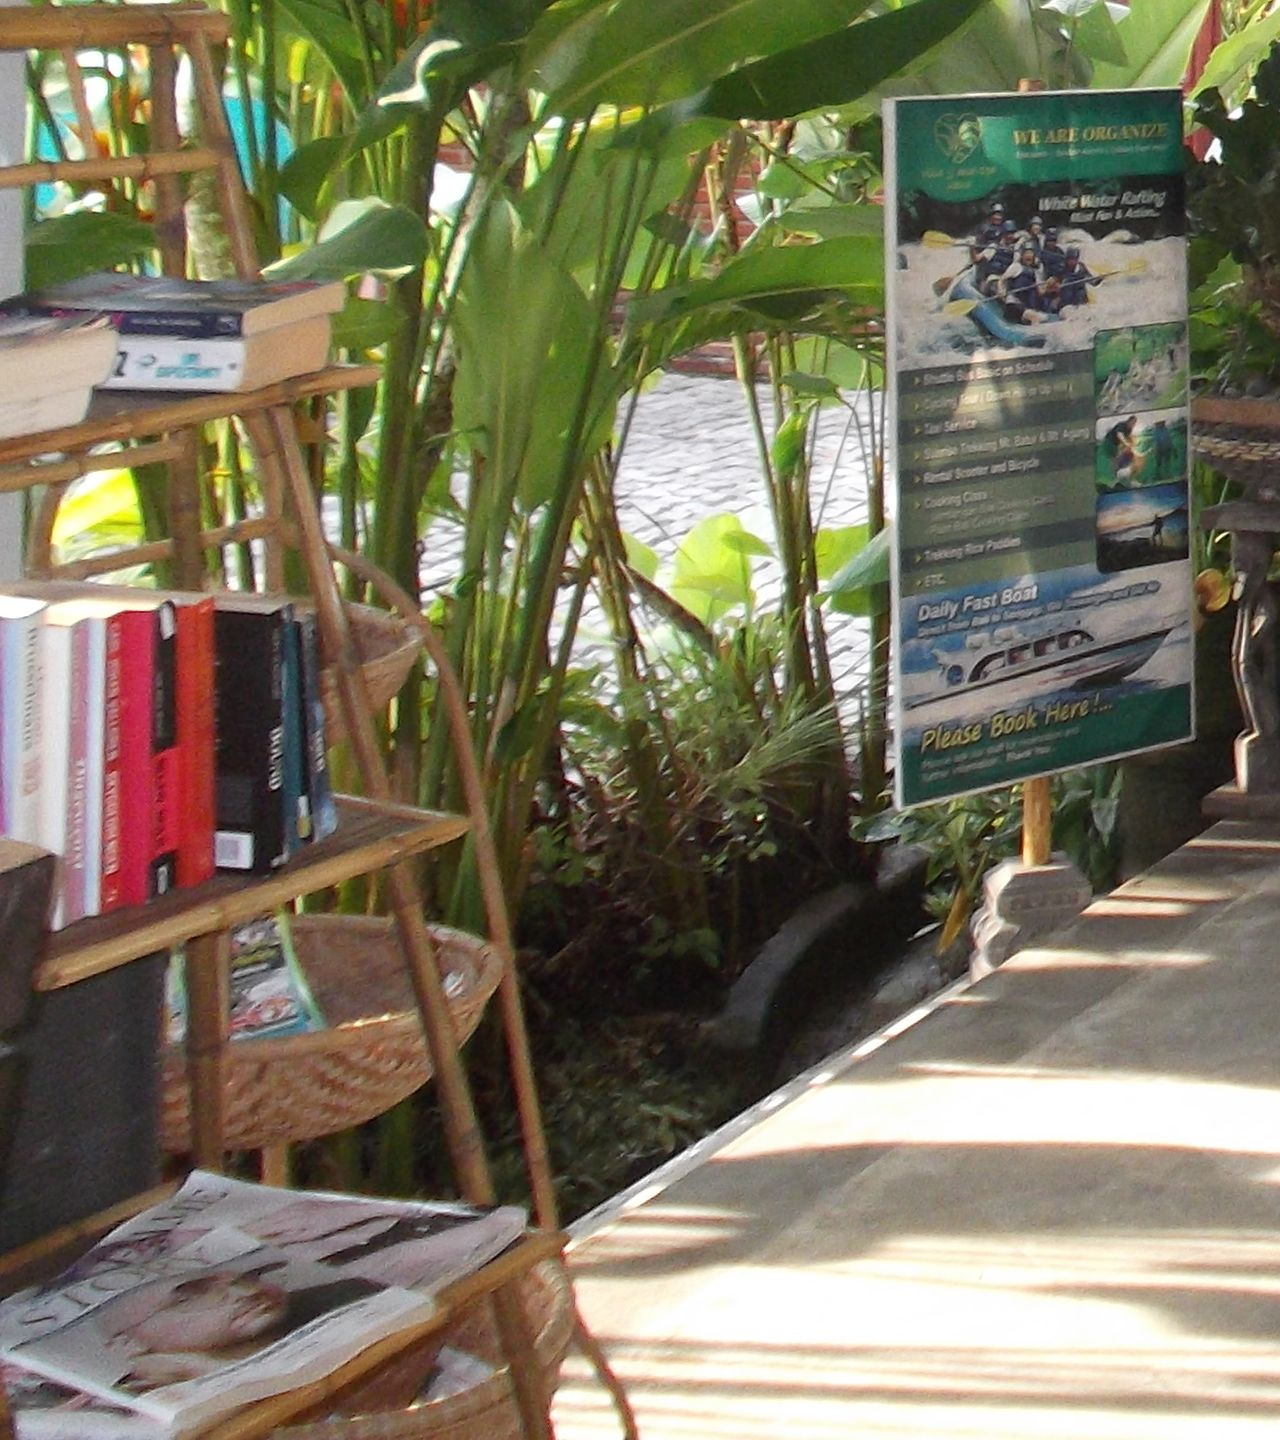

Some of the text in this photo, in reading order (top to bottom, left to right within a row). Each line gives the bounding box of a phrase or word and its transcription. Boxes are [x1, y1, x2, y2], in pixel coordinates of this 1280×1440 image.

[1013, 122, 1169, 146] WE ARE ORGANIZE
[1038, 190, 1166, 212] White Water Rafting
[989, 461, 1007, 475] and
[1007, 457, 1040, 474] Bicycle
[924, 490, 988, 509] Cooking Class
[917, 599, 959, 622] Daily
[963, 593, 998, 612] Fast
[1000, 583, 1039, 607] Boat
[920, 724, 983, 753] Please
[989, 707, 1038, 739] Book
[1045, 697, 1089, 725] Here
[268, 726, 283, 792] BOUND
